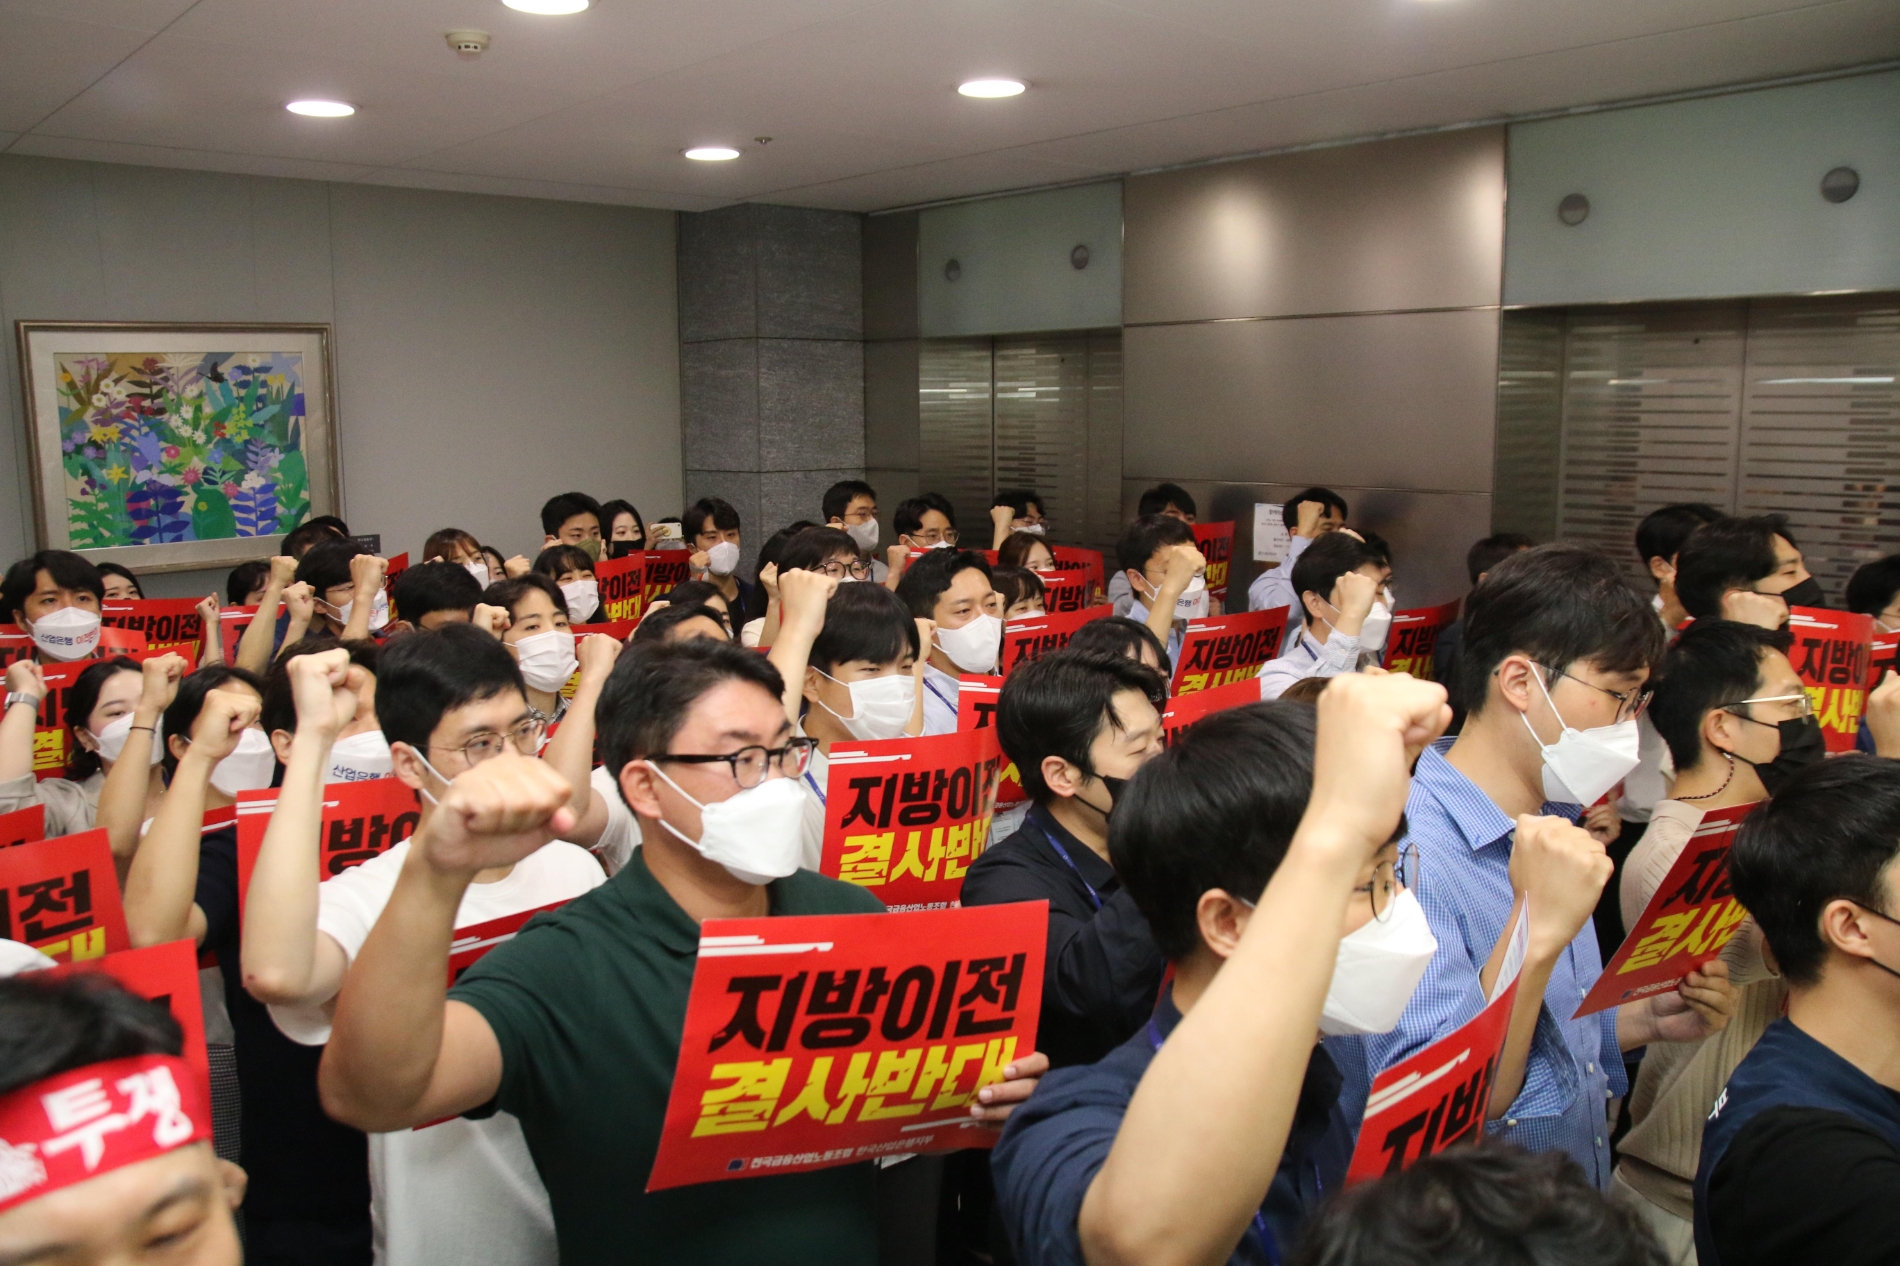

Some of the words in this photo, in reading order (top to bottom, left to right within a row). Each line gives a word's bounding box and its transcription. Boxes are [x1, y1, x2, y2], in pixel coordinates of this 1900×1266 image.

[1184, 626, 1281, 671] 지방이전
[707, 952, 1027, 1054] 지방이전
[40, 1065, 194, 1172] 투쟁
[690, 1036, 1018, 1138] 결사반대
